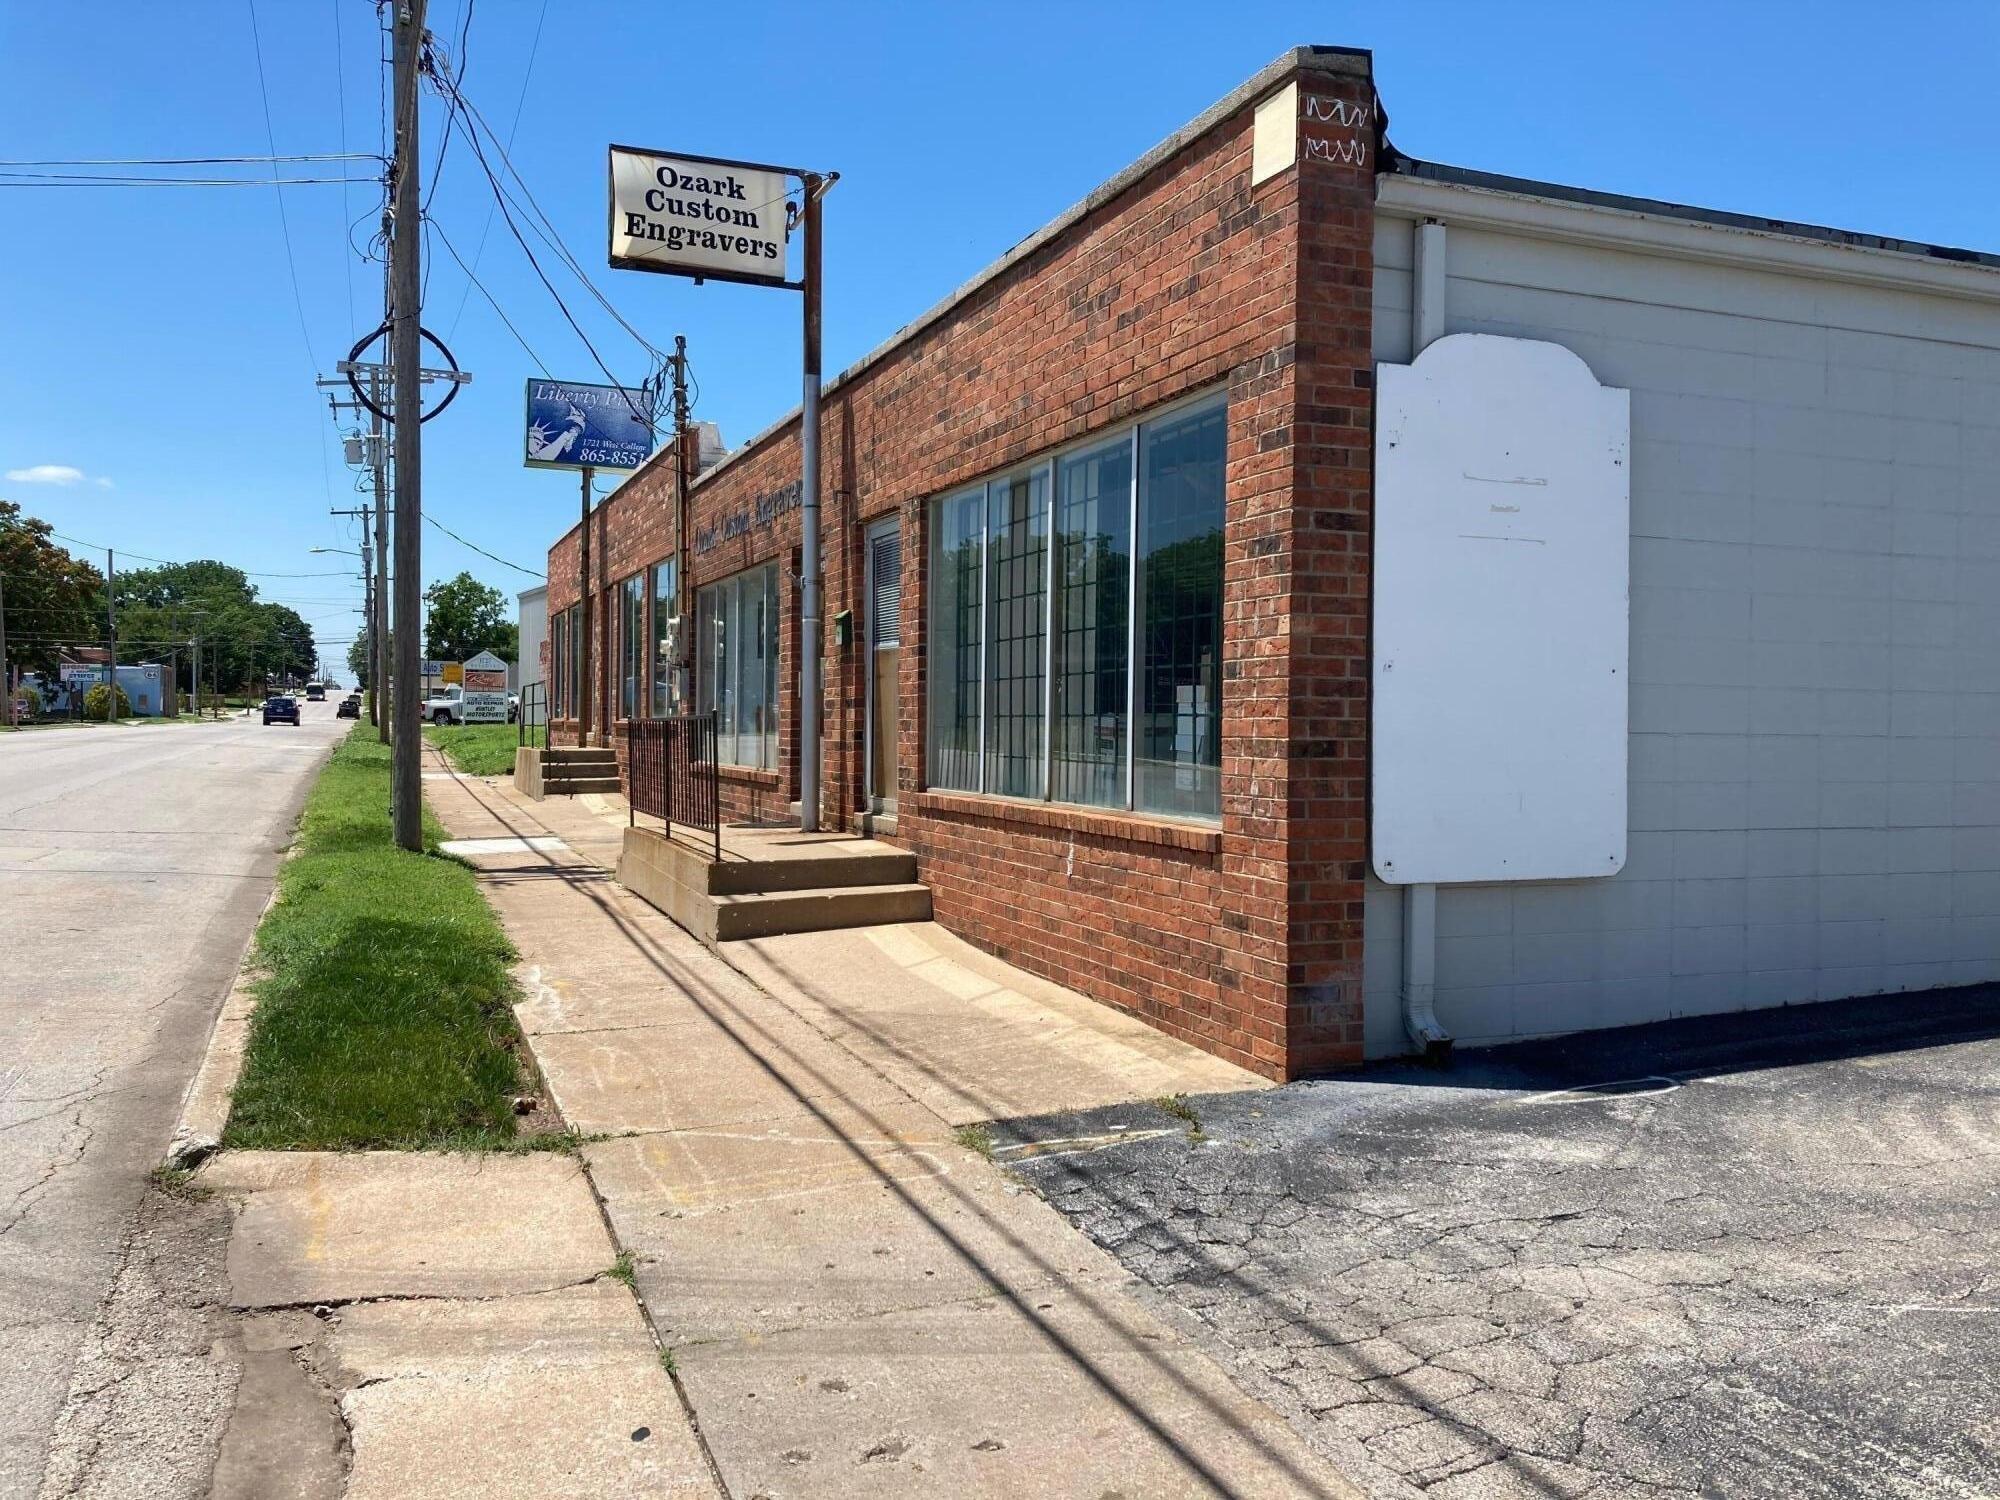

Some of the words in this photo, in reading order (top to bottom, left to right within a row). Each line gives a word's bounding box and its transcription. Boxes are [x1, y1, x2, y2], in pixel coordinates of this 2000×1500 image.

[656, 166, 746, 200] Ozark
[645, 189, 759, 229] Custom
[623, 211, 778, 259] Engravers
[535, 383, 599, 409] Liberty
[580, 448, 645, 465] 865-8551
[583, 439, 600, 448] 1721
[603, 440, 619, 449] West
[621, 442, 647, 453] College
